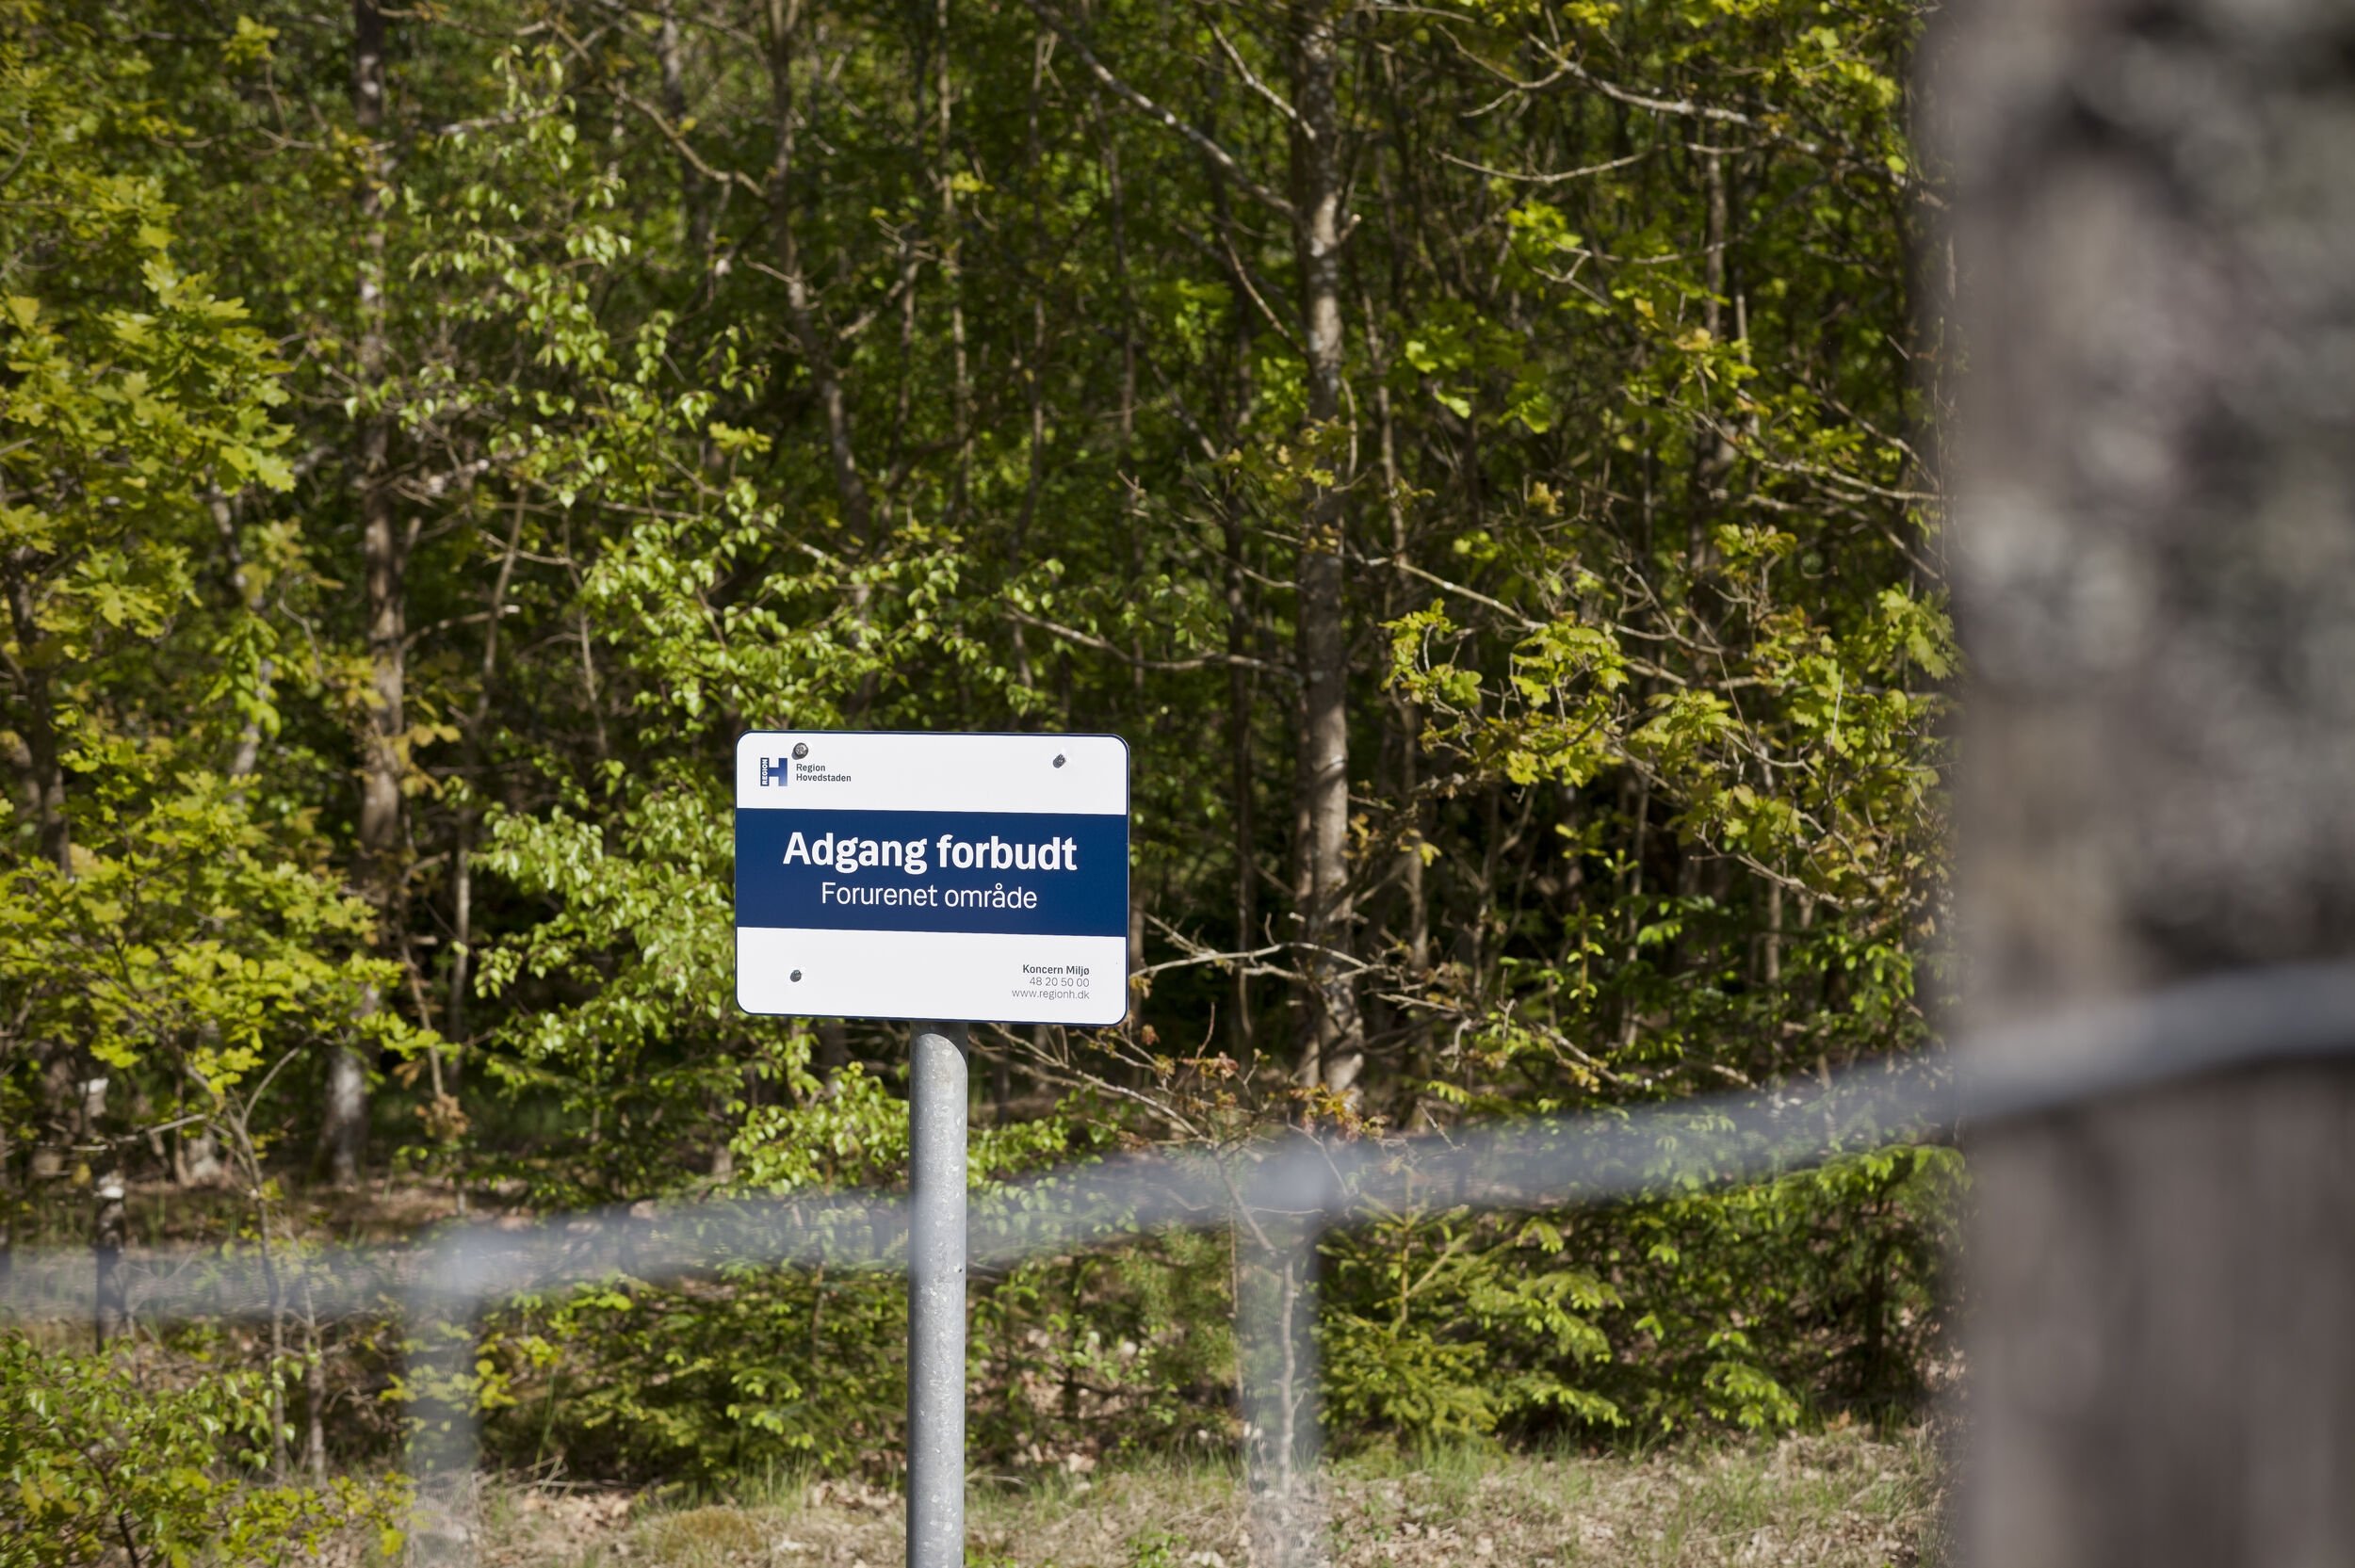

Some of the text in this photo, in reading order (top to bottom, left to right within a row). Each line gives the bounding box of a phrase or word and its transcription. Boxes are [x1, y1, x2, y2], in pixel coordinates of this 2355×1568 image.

[796, 764, 826, 773] Region
[796, 773, 852, 782] Hovedstaden
[783, 832, 1078, 875] Adgang forbudt
[821, 881, 1037, 910] Forurenet område
[1022, 964, 1090, 977] Koncern Miljø
[1030, 977, 1090, 988] 48 20 50 00
[1012, 989, 1090, 1000] www.regionh.dk
